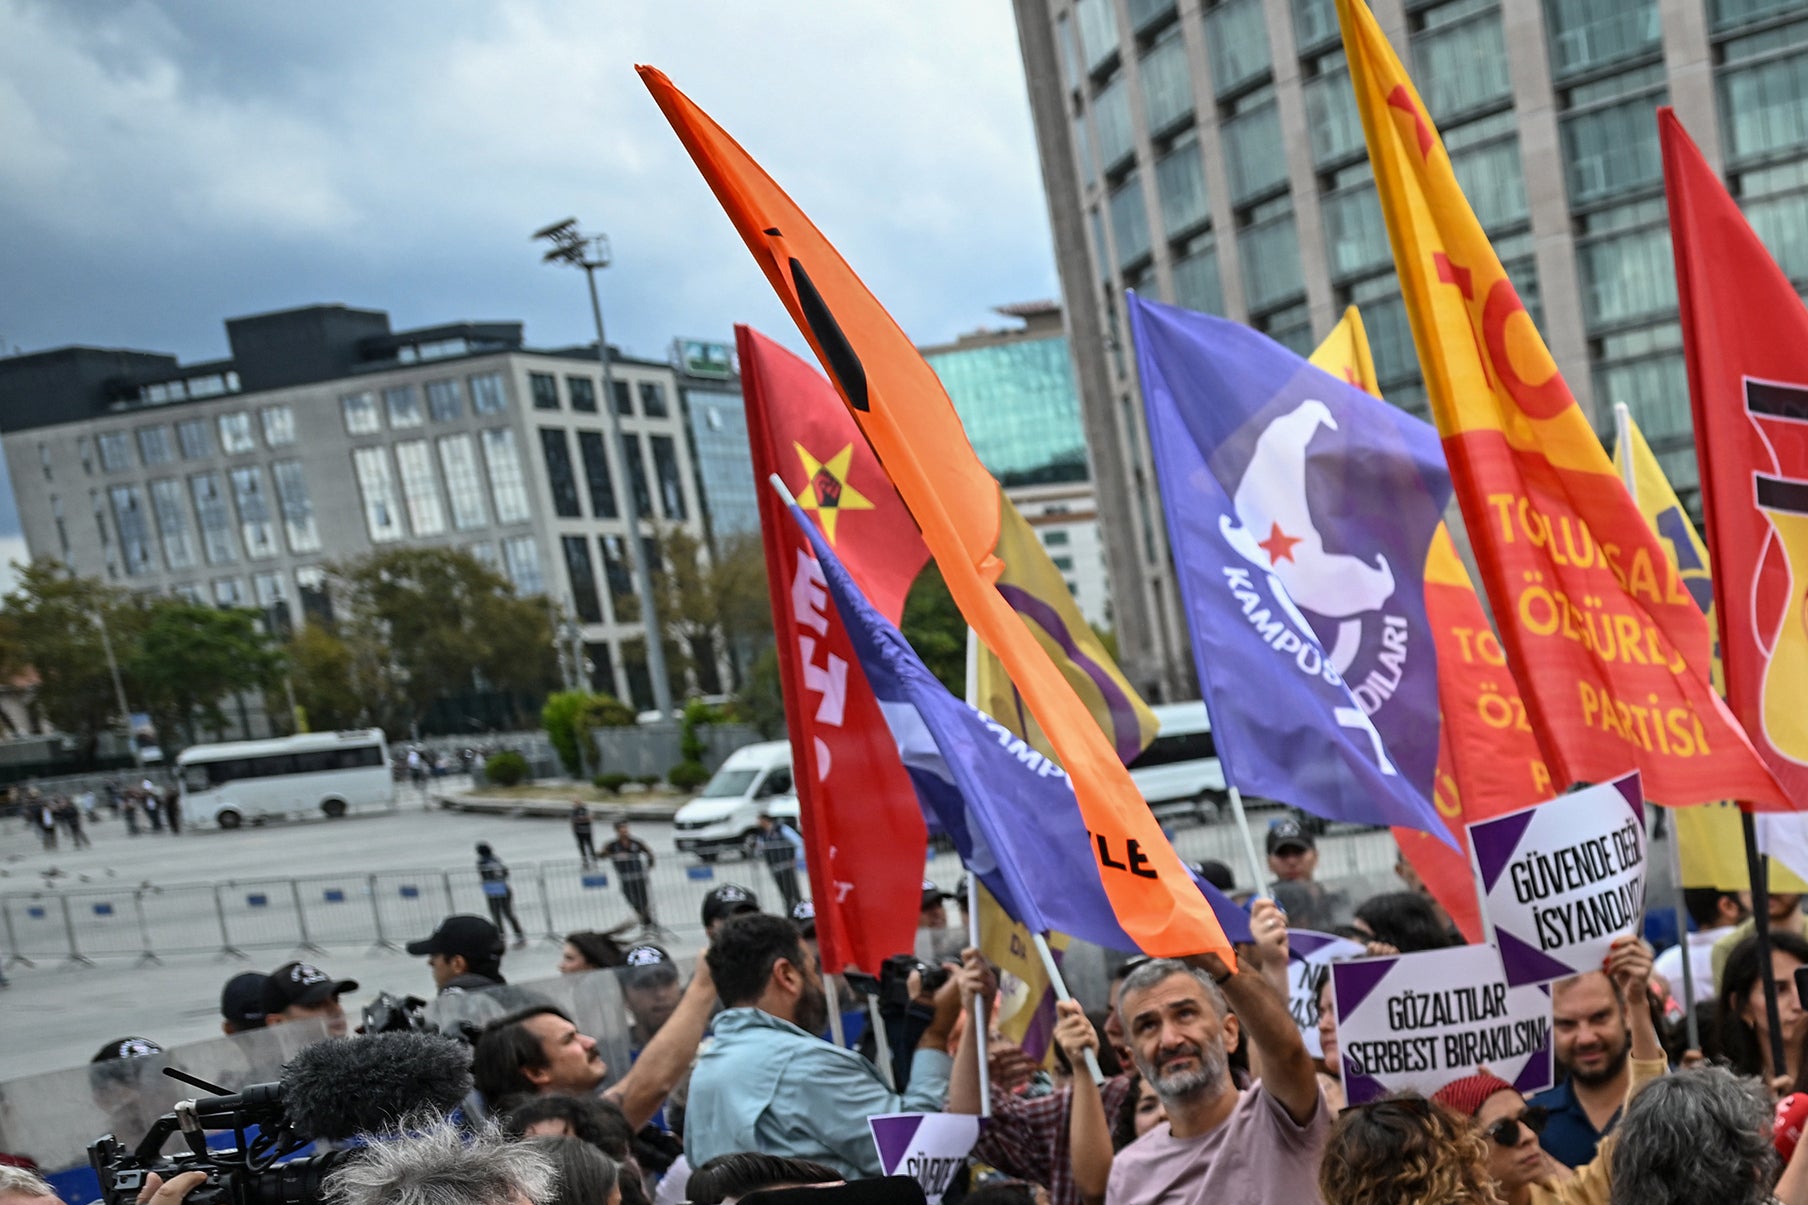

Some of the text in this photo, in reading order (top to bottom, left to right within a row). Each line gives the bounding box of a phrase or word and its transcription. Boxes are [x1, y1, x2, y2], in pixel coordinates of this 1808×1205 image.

[1510, 836, 1616, 905] GÜVENDE
[1387, 982, 1508, 1032] GÖZALTILAR
[1348, 1016, 1547, 1076] SERBEST BIRAKILSIN!
